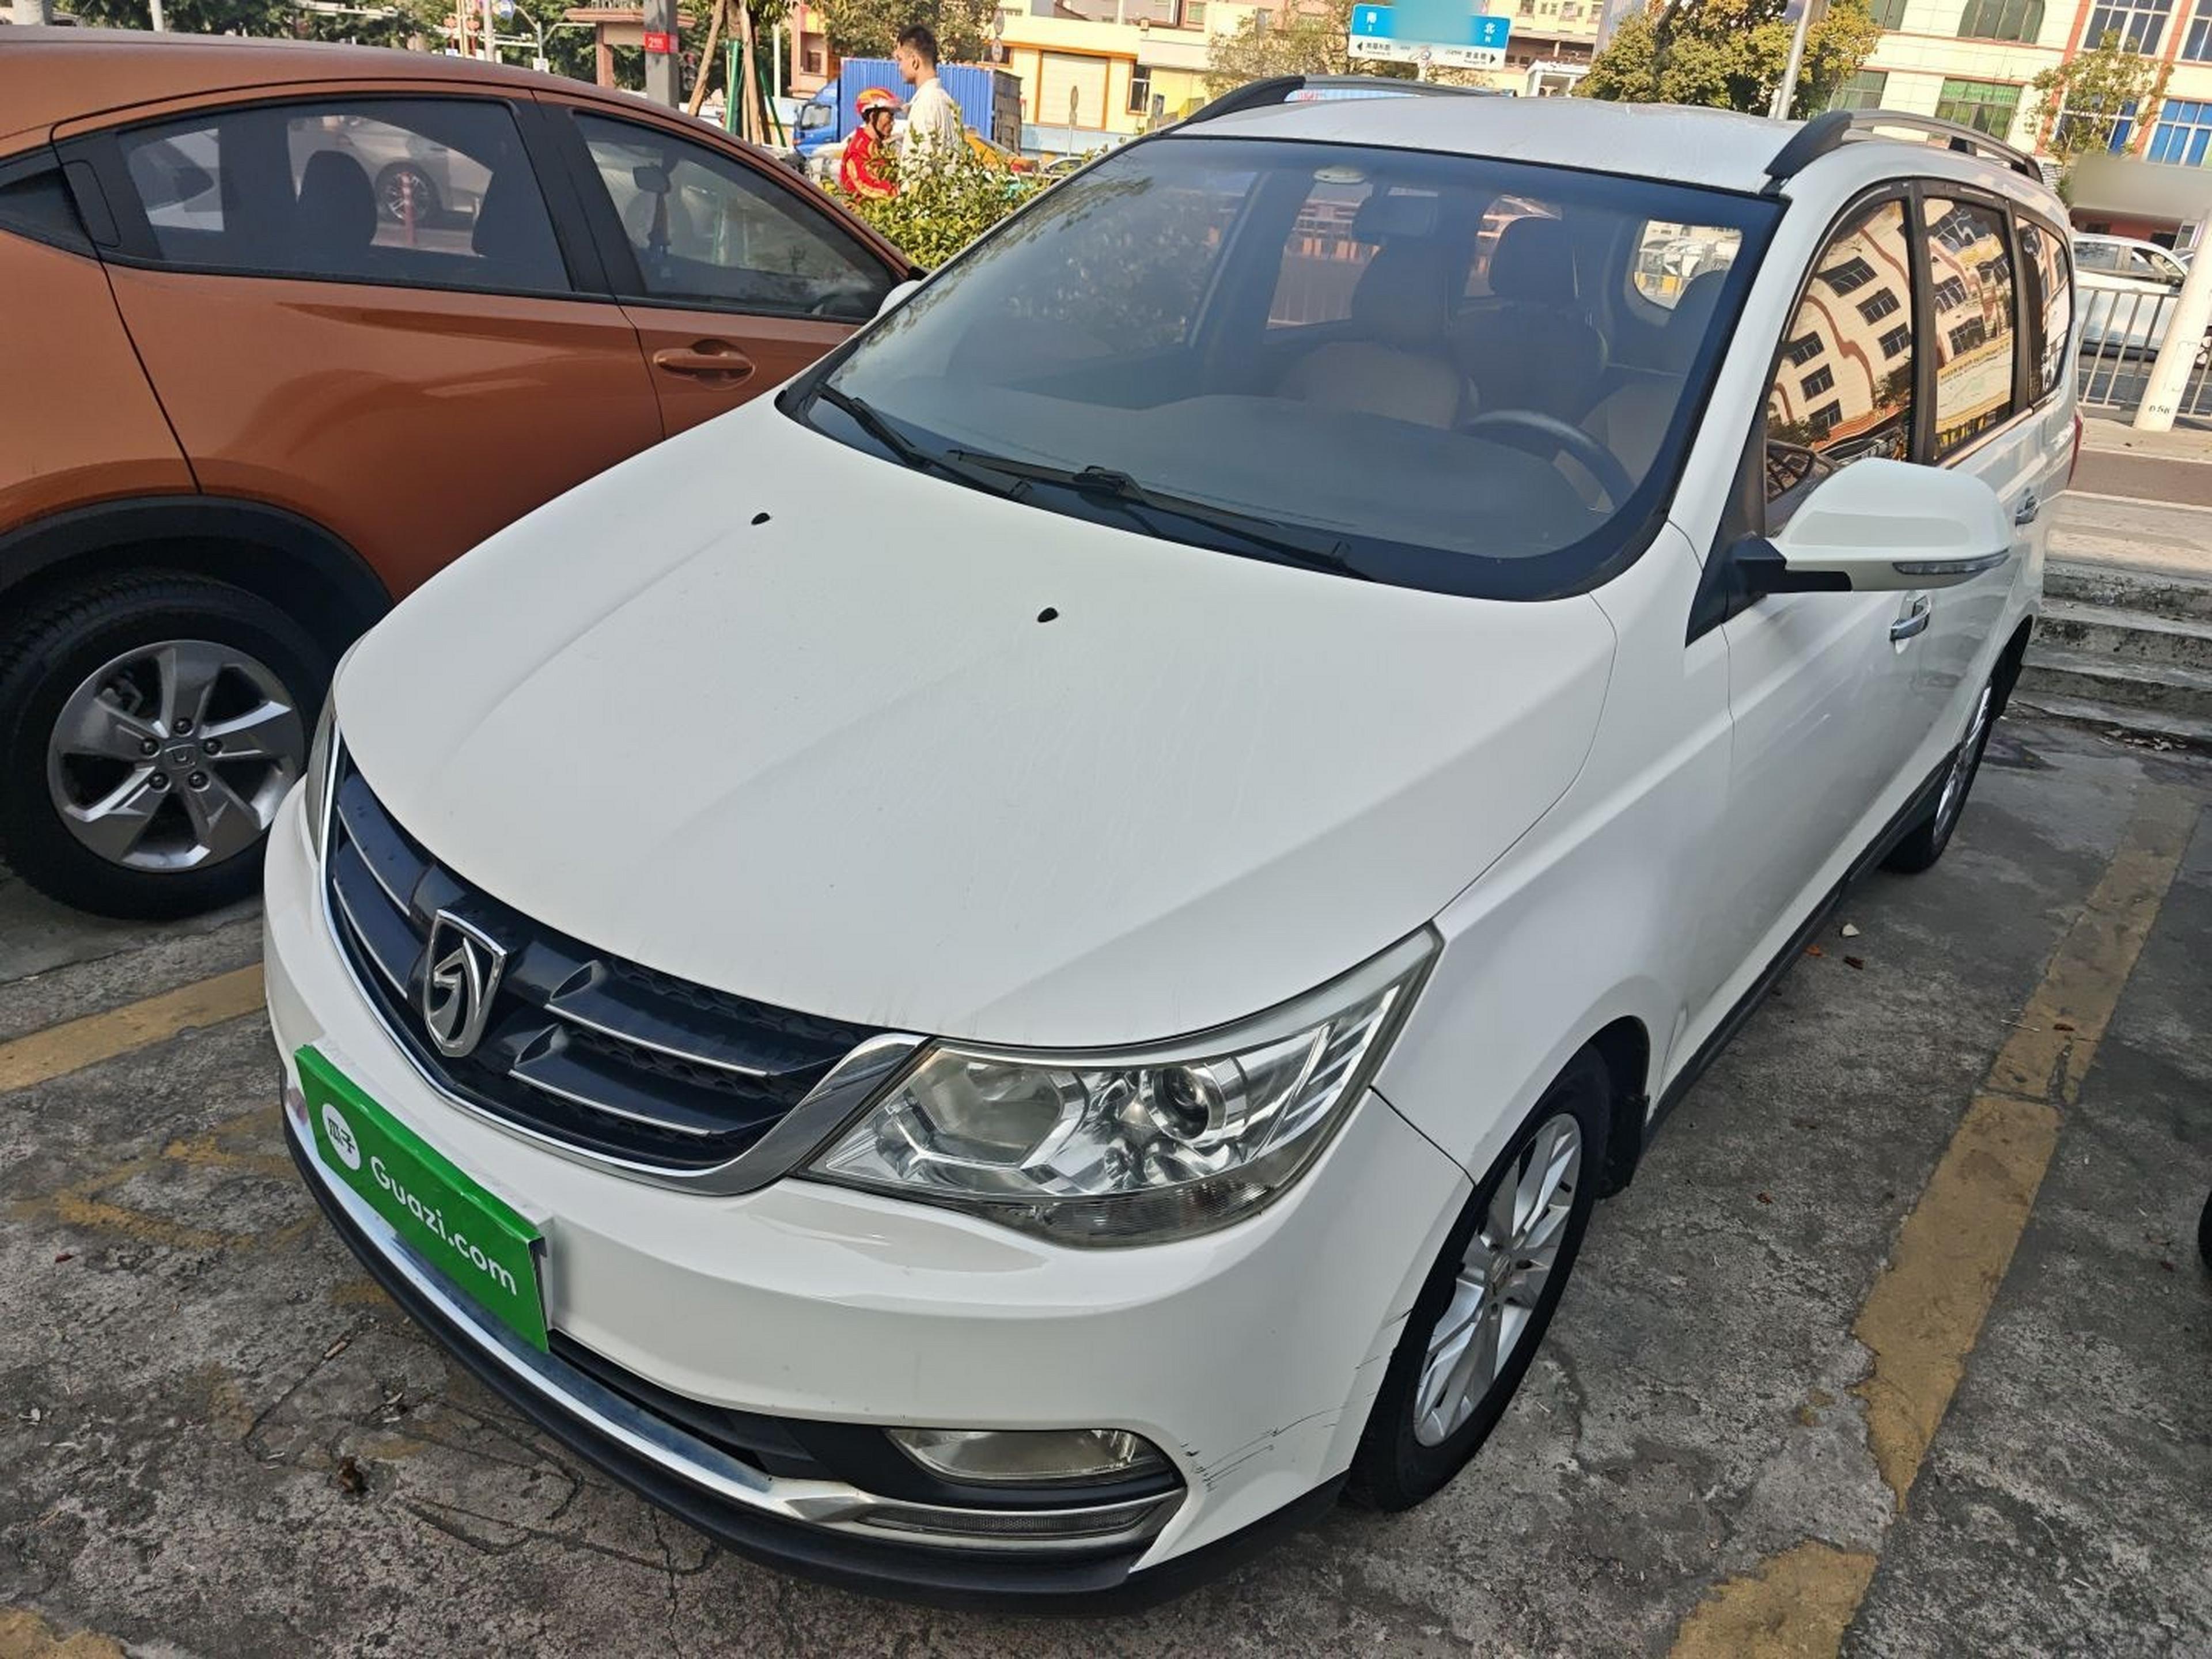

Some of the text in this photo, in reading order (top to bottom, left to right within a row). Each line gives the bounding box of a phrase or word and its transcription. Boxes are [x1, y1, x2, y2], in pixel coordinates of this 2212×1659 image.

[1484, 22, 1496, 34] 北
[327, 1118, 355, 1154] 瓜子
[370, 1156, 517, 1296] Guazi.com
